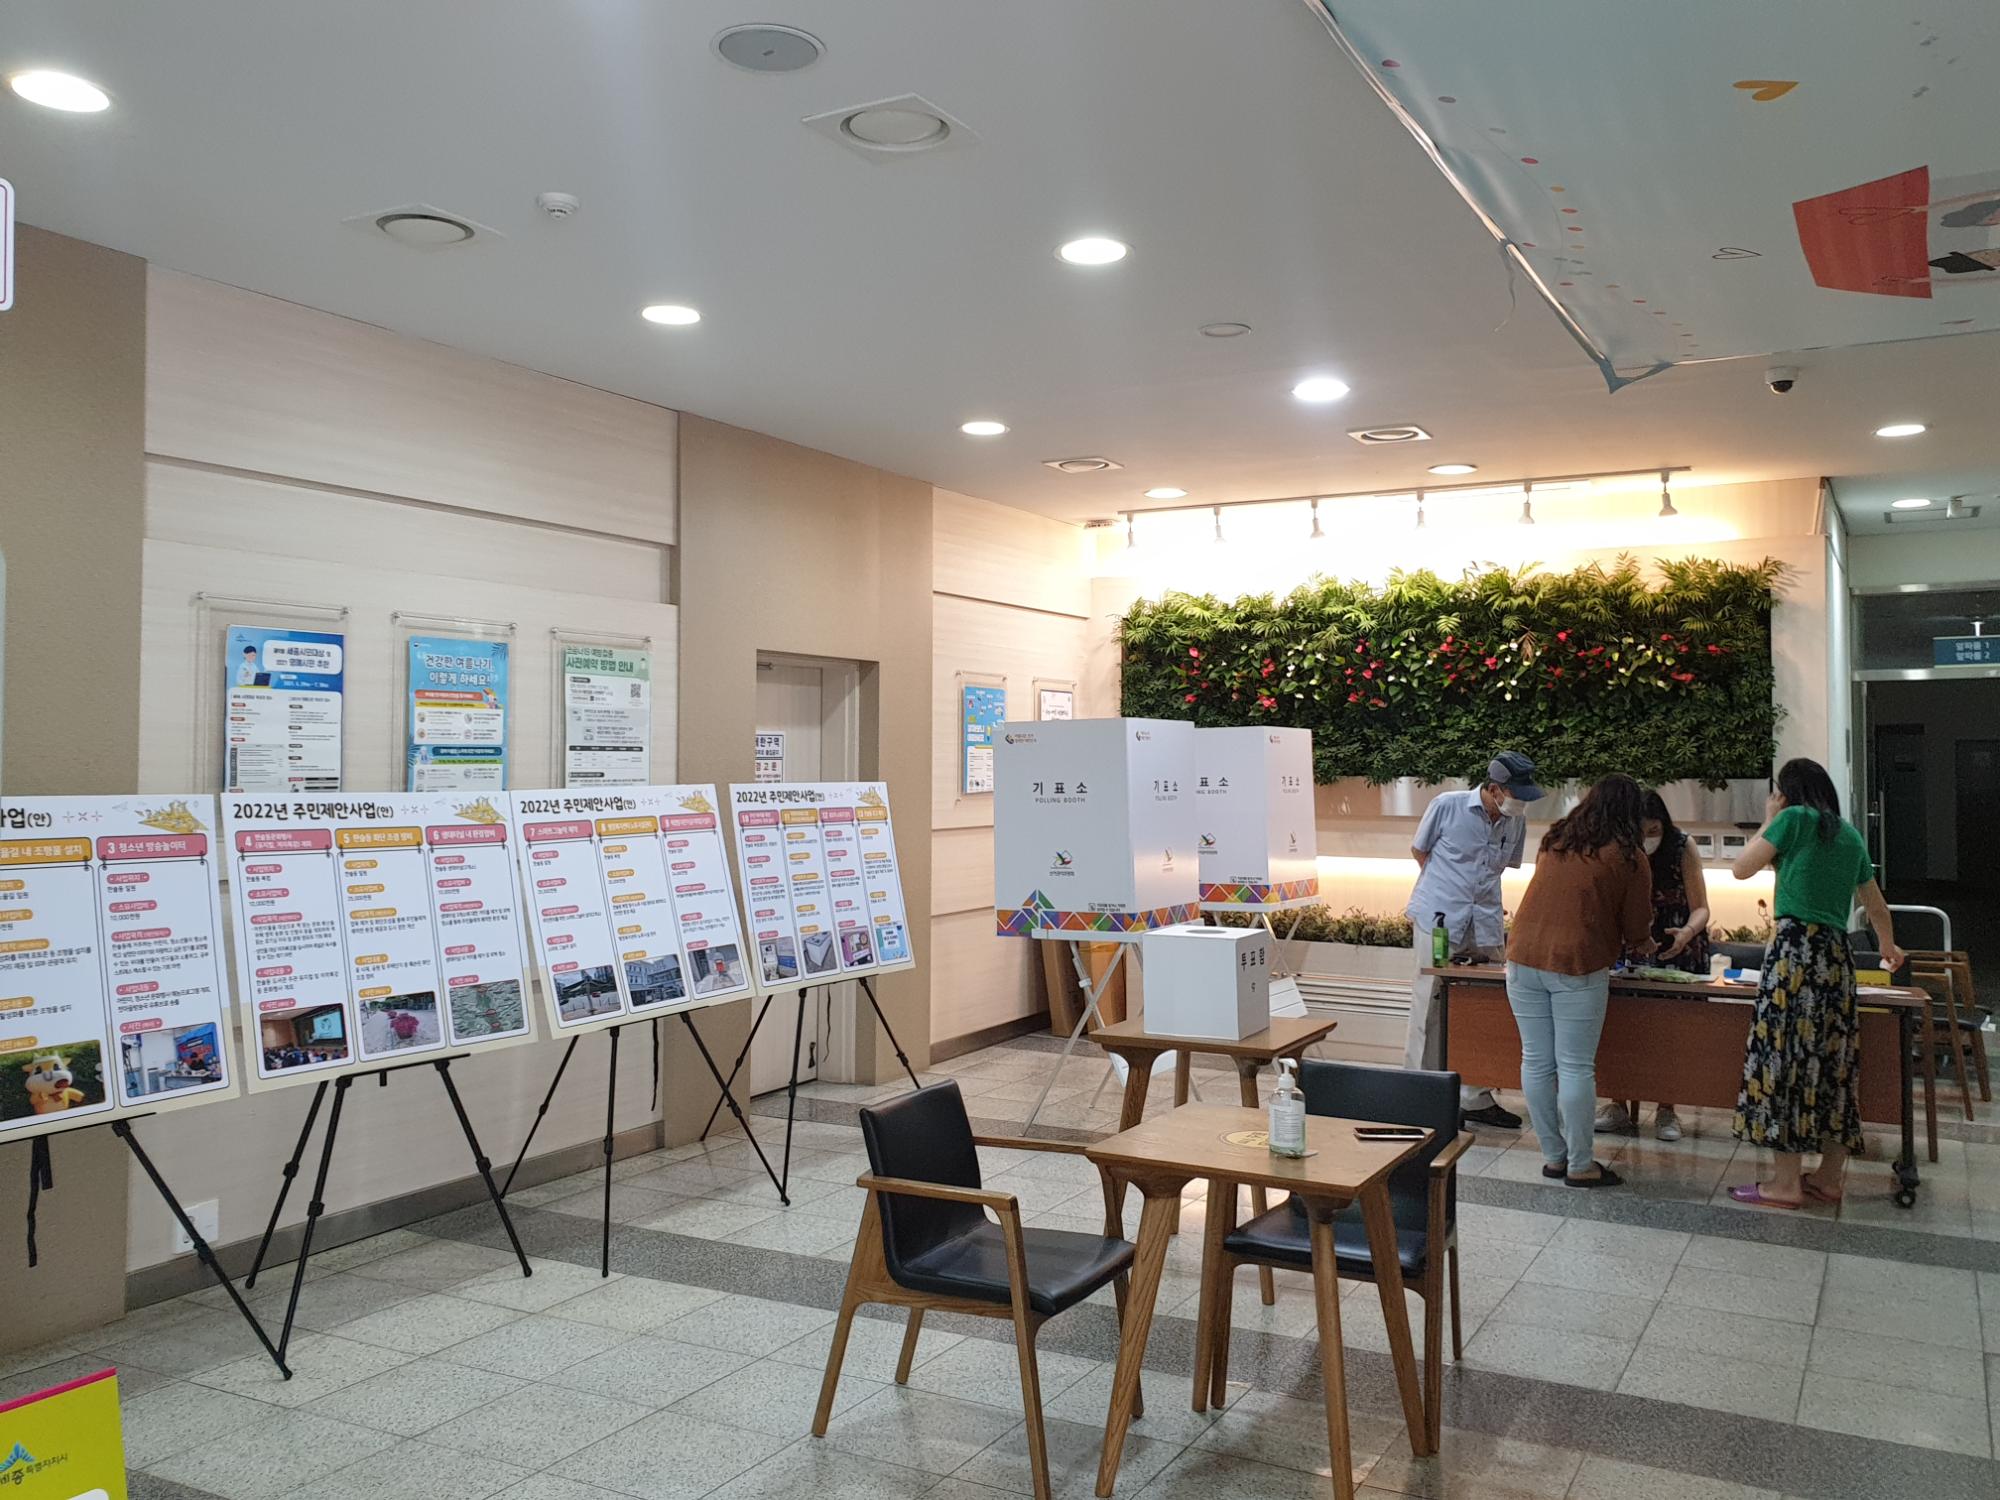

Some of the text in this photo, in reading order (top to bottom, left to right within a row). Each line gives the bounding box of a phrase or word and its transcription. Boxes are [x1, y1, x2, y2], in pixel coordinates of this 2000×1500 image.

[425, 655, 455, 669] 건강한
[566, 657, 634, 672] 사전예약 방법 안내
[429, 672, 457, 685] 이렇게
[756, 737, 780, 747] 한구역
[1199, 776, 1229, 787] 표소
[736, 791, 767, 804] 2022년
[233, 802, 394, 821] 2022년 주민제안사업(안)
[521, 797, 636, 814] 2022년 주민제안사업(안)
[343, 833, 351, 843] 5
[433, 831, 439, 840] 6
[530, 827, 535, 836] 7
[107, 841, 187, 854] 3 청소년 방송놀이터
[245, 836, 252, 847] 4
[22, 846, 32, 857] 내
[26, 1453, 68, 1474] 특별자치시
